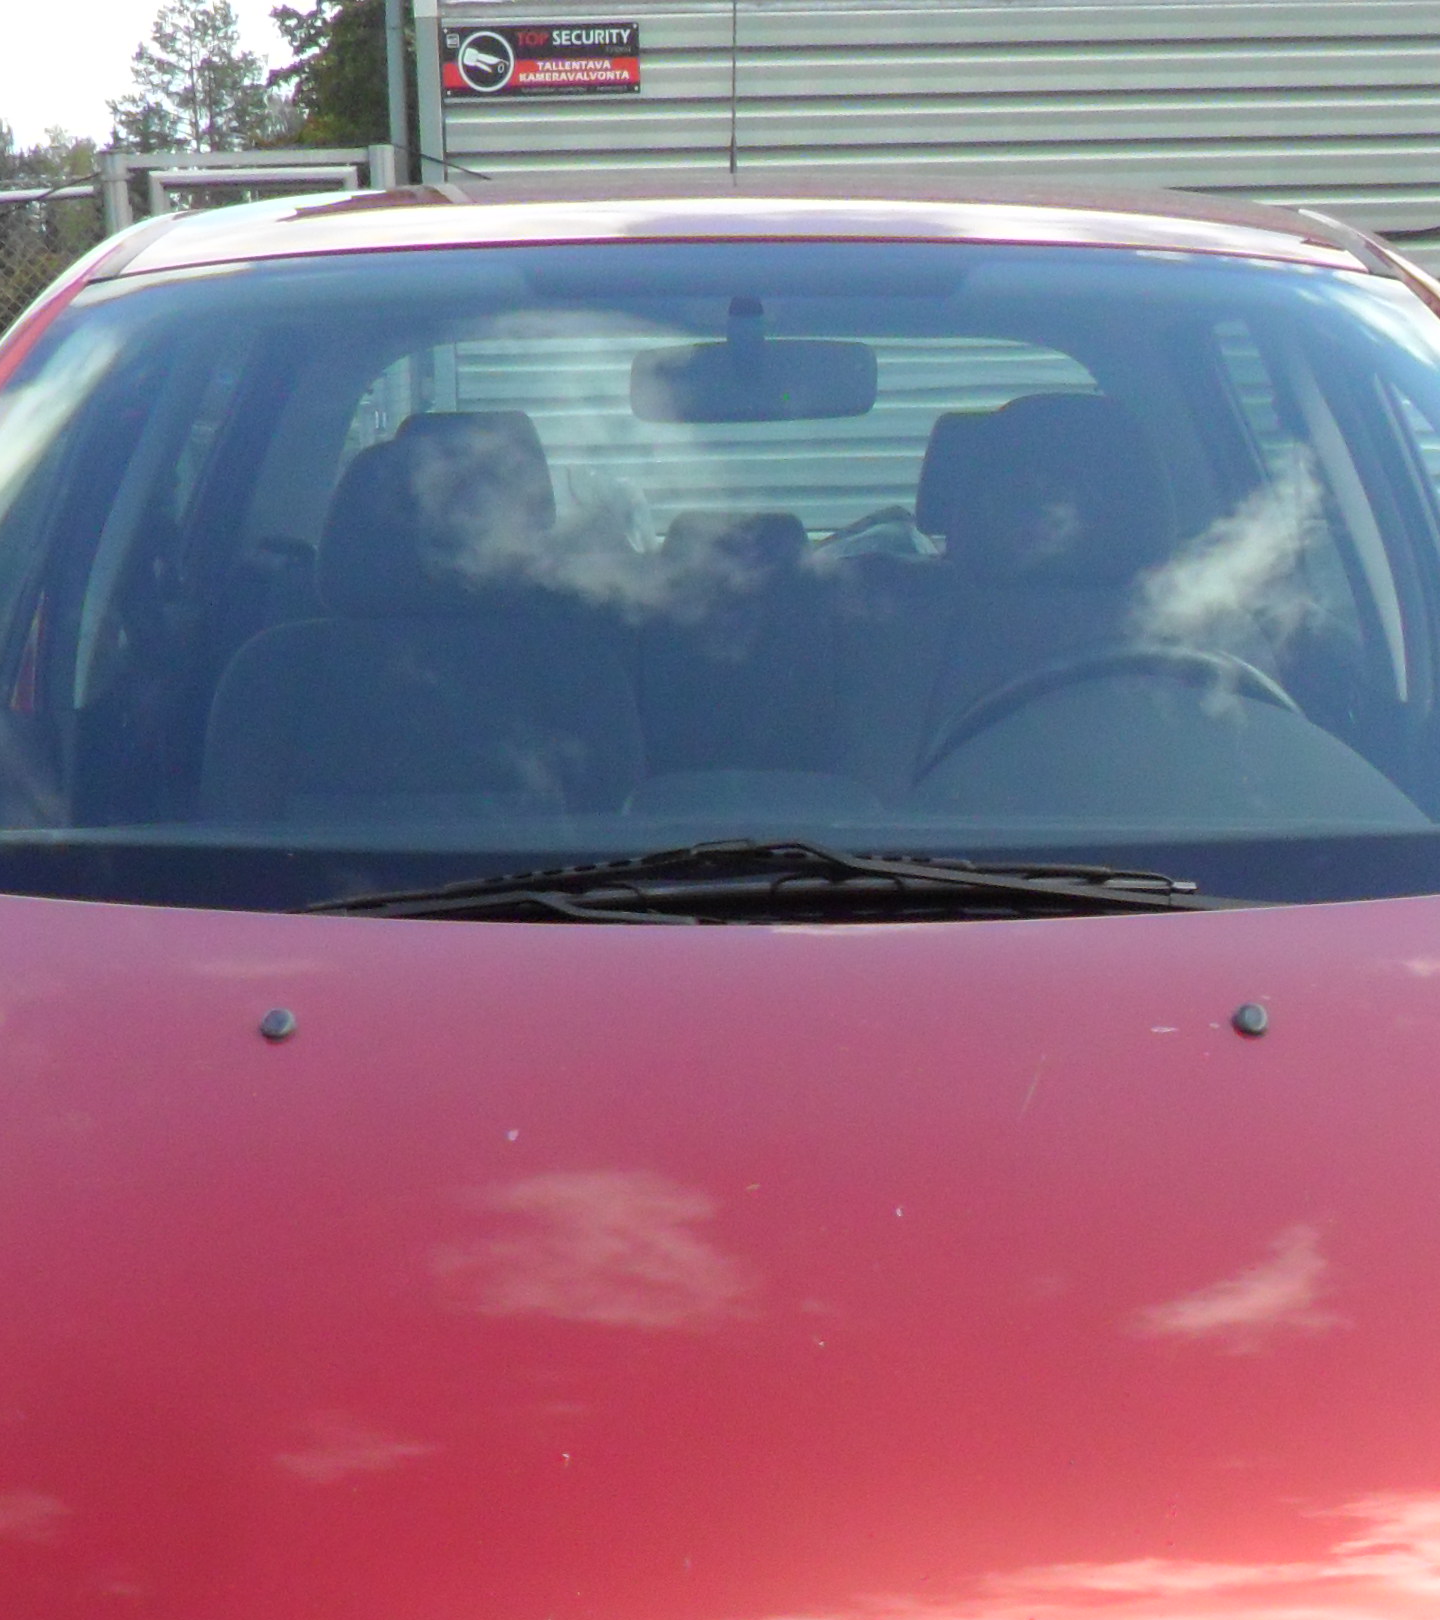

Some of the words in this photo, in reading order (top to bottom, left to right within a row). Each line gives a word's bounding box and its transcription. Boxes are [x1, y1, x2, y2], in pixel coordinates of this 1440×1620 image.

[517, 32, 549, 47] TOP
[552, 29, 631, 45] SECURITY
[536, 60, 611, 71] TALLENTAVA
[518, 71, 630, 82] KAMERAVALVONTA
